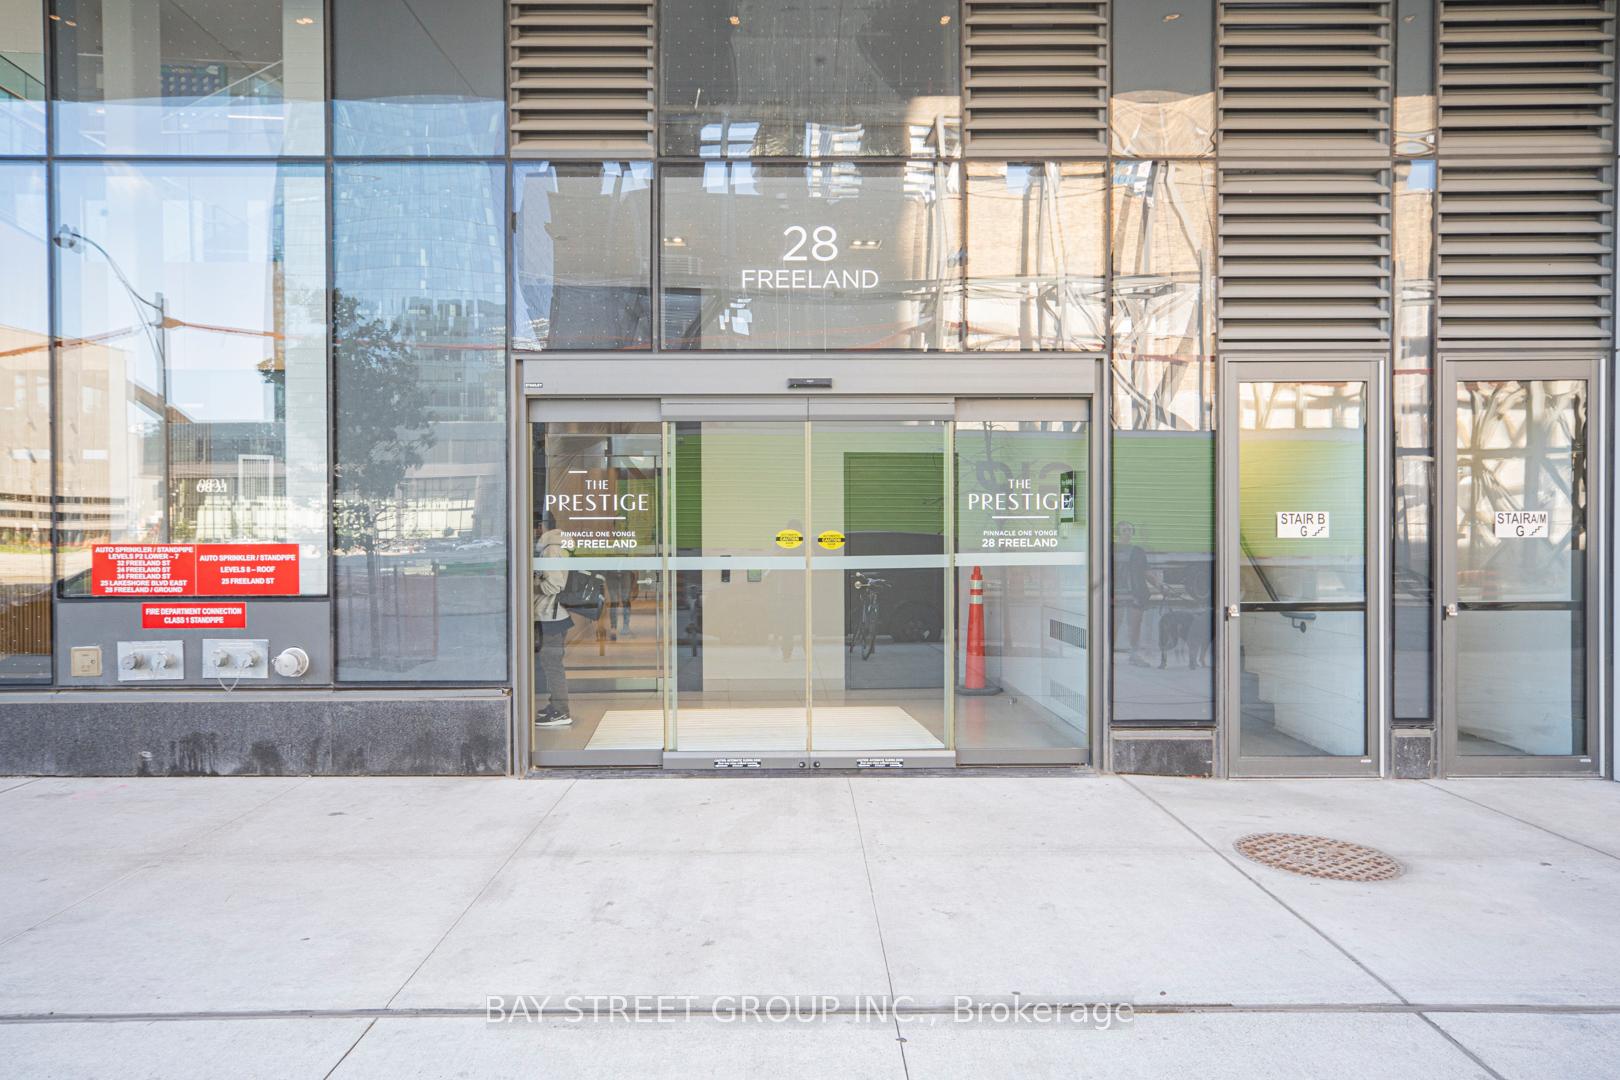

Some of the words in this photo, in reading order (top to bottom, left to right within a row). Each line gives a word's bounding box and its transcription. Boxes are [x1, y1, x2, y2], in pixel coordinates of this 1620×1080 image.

[783, 225, 838, 262] 28
[742, 269, 879, 289] FREELAND
[585, 480, 609, 490] THE
[1008, 479, 1031, 489] THE
[545, 493, 649, 512] PRESTIGE
[968, 493, 1073, 511] PRESTIGE
[1281, 513, 1314, 525] STAIR
[1317, 513, 1326, 525] B
[1300, 525, 1308, 537] G
[1515, 525, 1525, 537] G
[560, 539, 575, 549] 28
[577, 539, 637, 549] FREELAND
[982, 538, 996, 548] 28
[998, 538, 1058, 548] FREELAND
[145, 607, 160, 615] FIRE
[160, 607, 201, 615] DEPARTMENT
[201, 607, 242, 615] CONNECTION
[163, 616, 185, 624] CLASS
[190, 616, 224, 624] STANDPIPE
